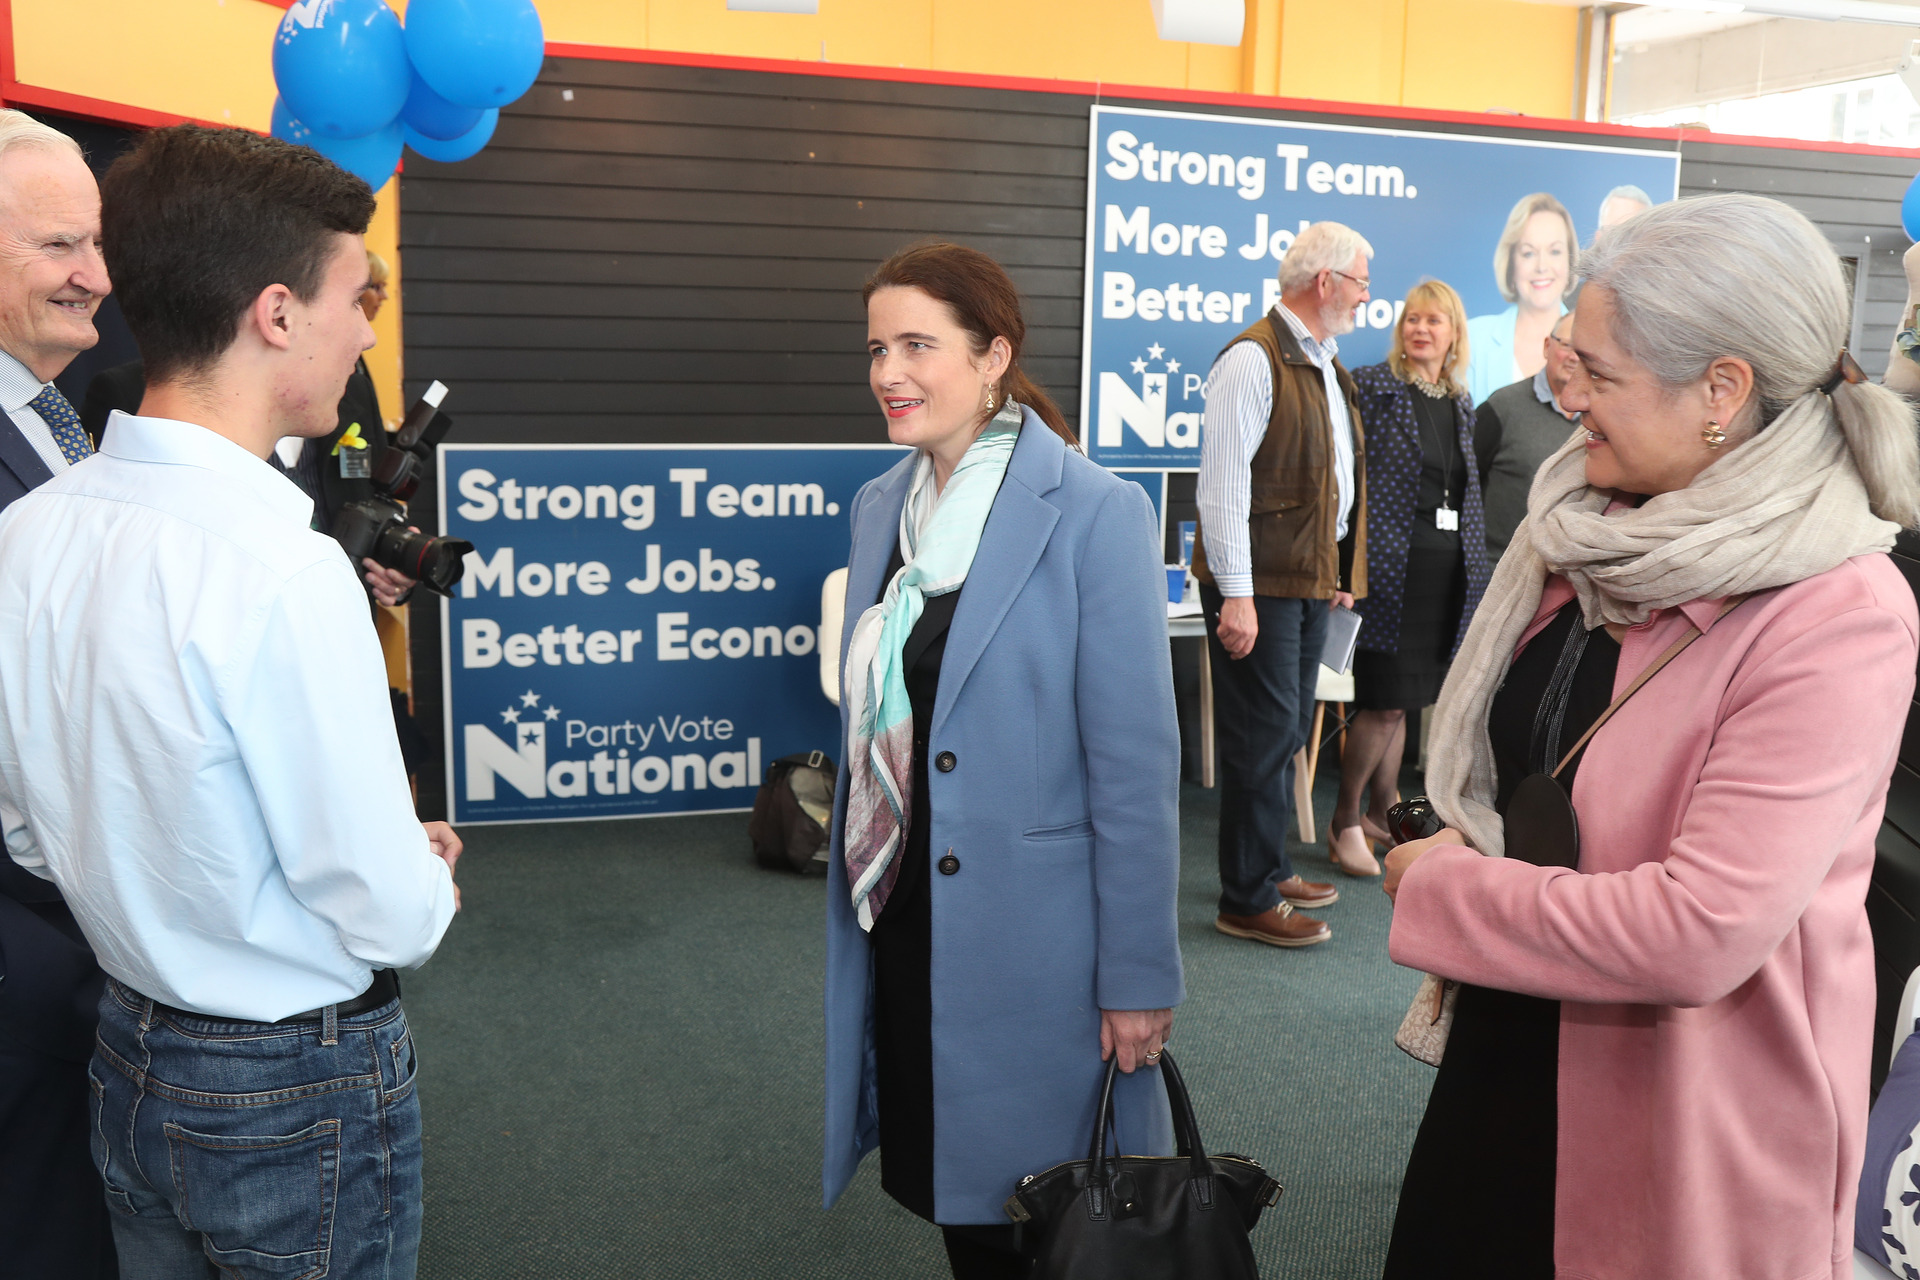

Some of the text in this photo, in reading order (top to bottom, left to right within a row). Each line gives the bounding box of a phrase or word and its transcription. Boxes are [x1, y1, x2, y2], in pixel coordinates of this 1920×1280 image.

[1104, 130, 1418, 200] Strong Team.
[1104, 204, 1228, 259] More
[1102, 271, 1251, 324] Better
[457, 467, 840, 531] Strong Team.
[461, 544, 776, 599] More Jobs.
[462, 611, 822, 669] Better Econo
[464, 721, 762, 801] National
[565, 715, 735, 751] Party Vote
